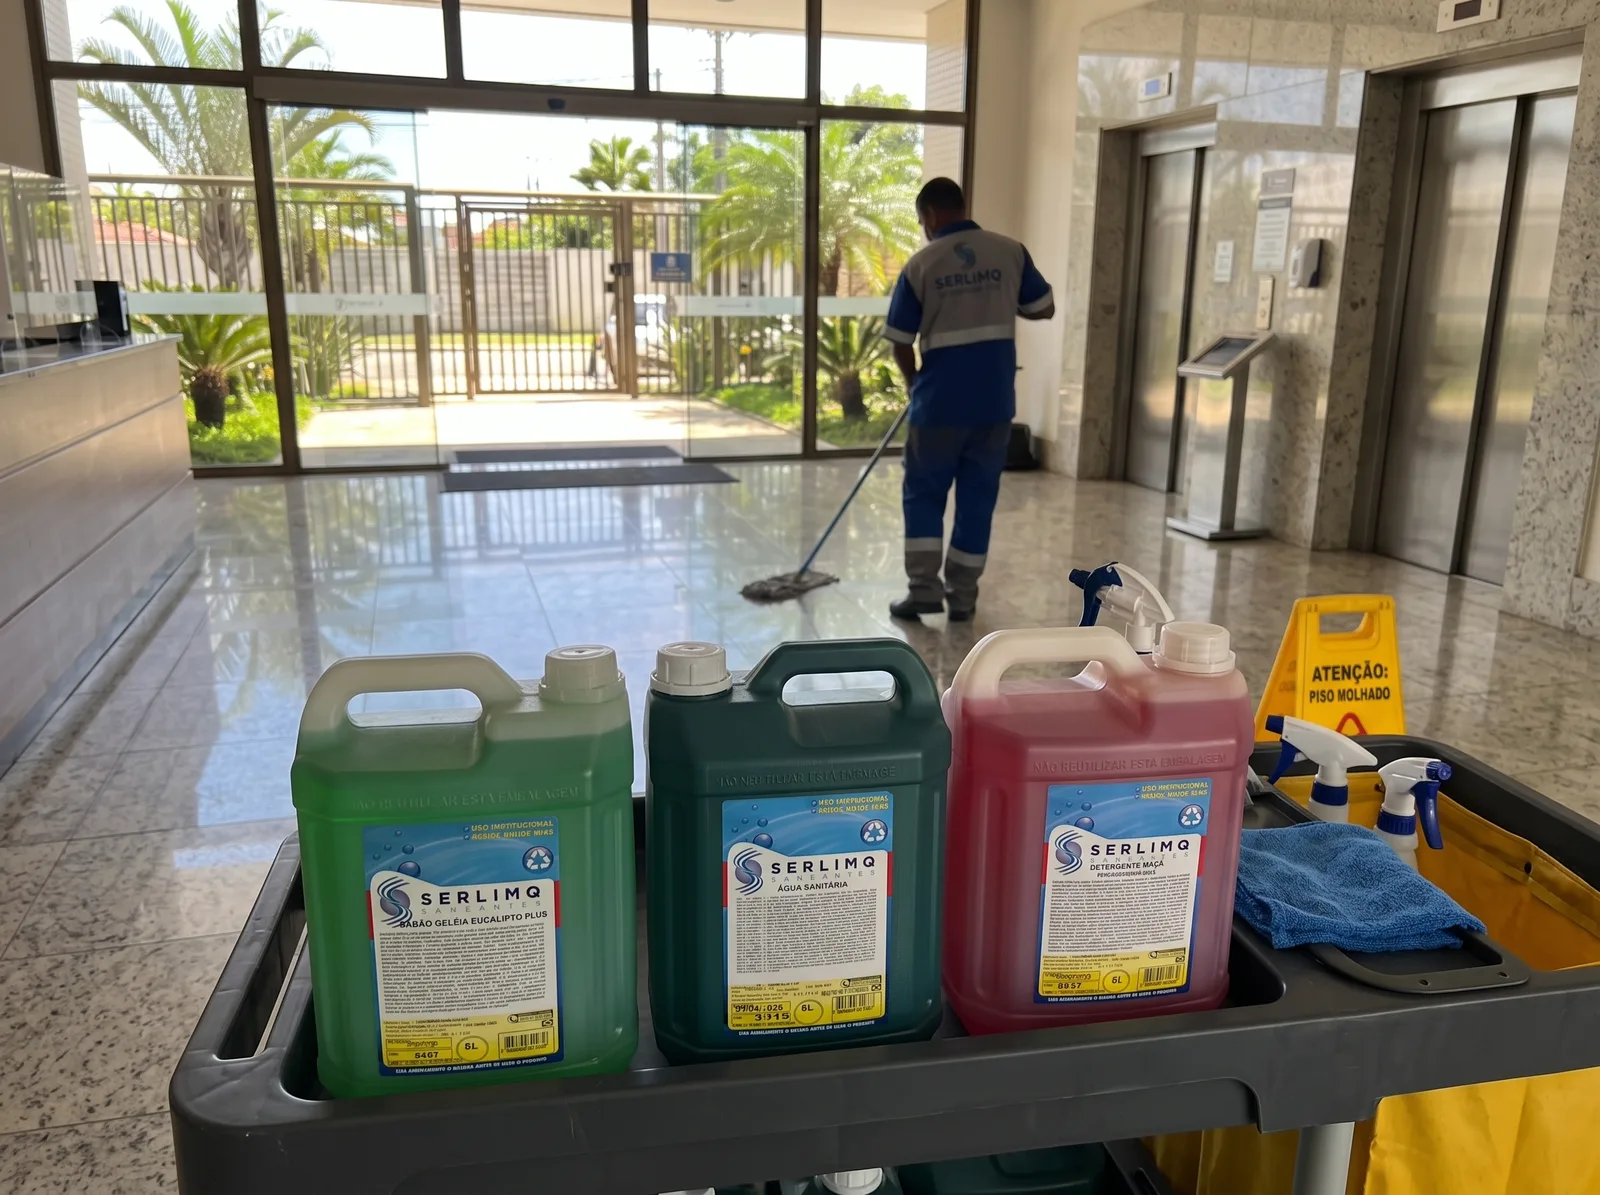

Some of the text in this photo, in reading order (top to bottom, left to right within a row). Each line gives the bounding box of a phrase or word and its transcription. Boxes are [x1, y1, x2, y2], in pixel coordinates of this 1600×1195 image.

[1312, 661, 1388, 684] ATENÇÃO:
[1309, 686, 1390, 703] PISO MOLHADO
[1130, 756, 1157, 769] ESTA
[471, 824, 489, 832] USO
[1090, 839, 1190, 856] SERLIMQ
[771, 855, 876, 874] SERLIMQ
[1089, 862, 1141, 871] DETERGENTE
[771, 870, 876, 883] SANEANTES
[777, 880, 848, 892] ÁGUA SANITÁRIA
[420, 885, 541, 906] SERLIMQ
[421, 900, 541, 915] SANEANTES
[399, 910, 548, 929] SABÃO GELÉIA EUCALIPTO PLUS
